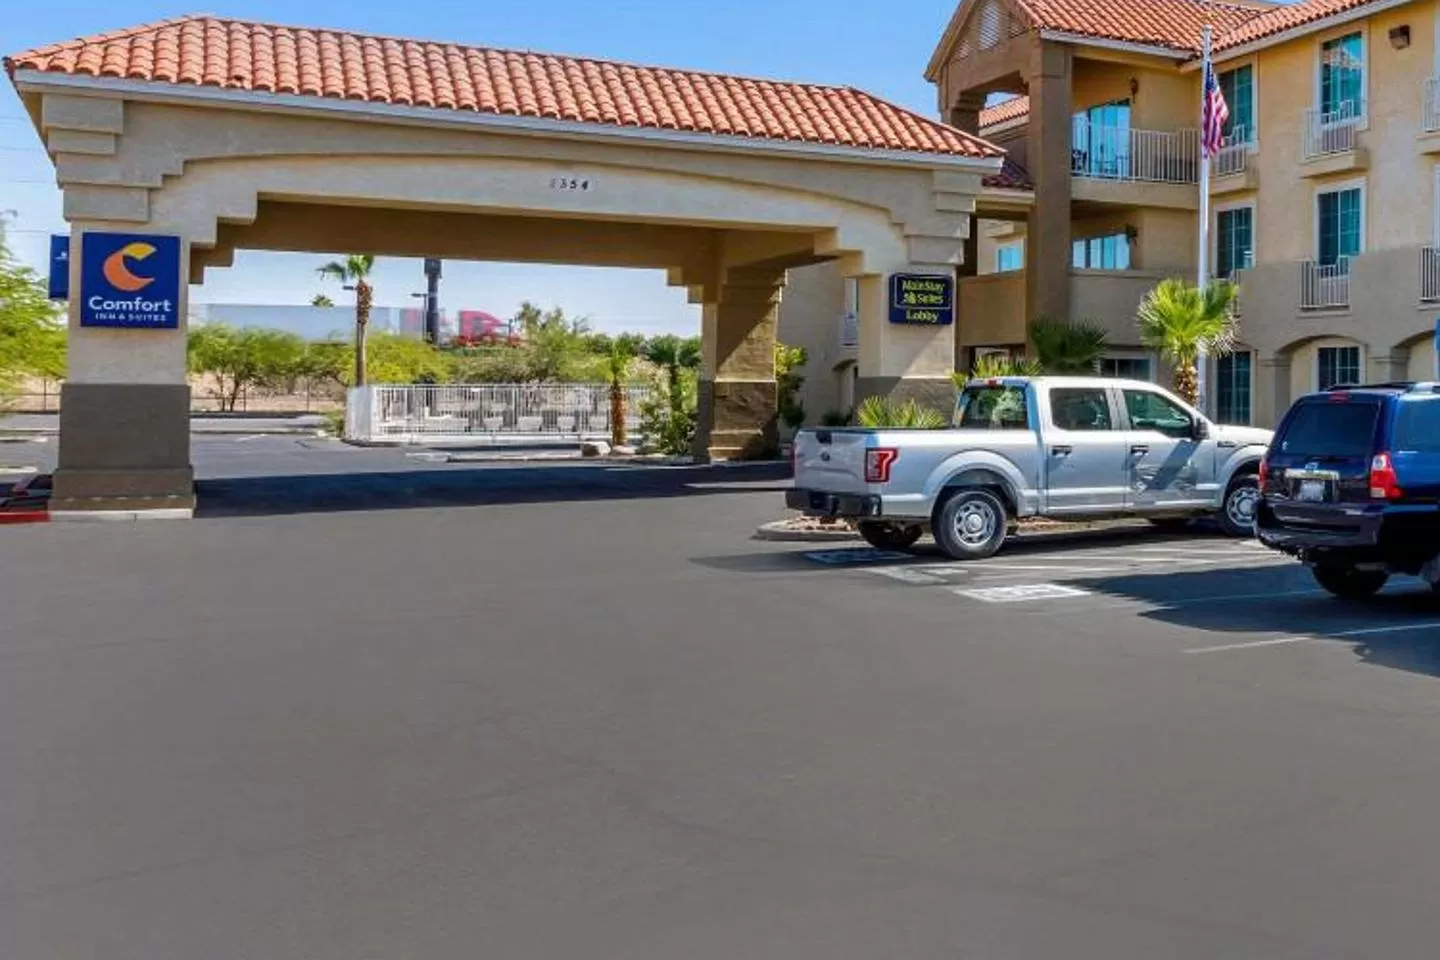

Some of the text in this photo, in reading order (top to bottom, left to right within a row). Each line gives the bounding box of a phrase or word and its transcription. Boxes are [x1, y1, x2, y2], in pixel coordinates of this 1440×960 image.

[88, 295, 173, 313] Comfort
[127, 313, 167, 322] SUITES
[906, 309, 939, 323] Lobby
